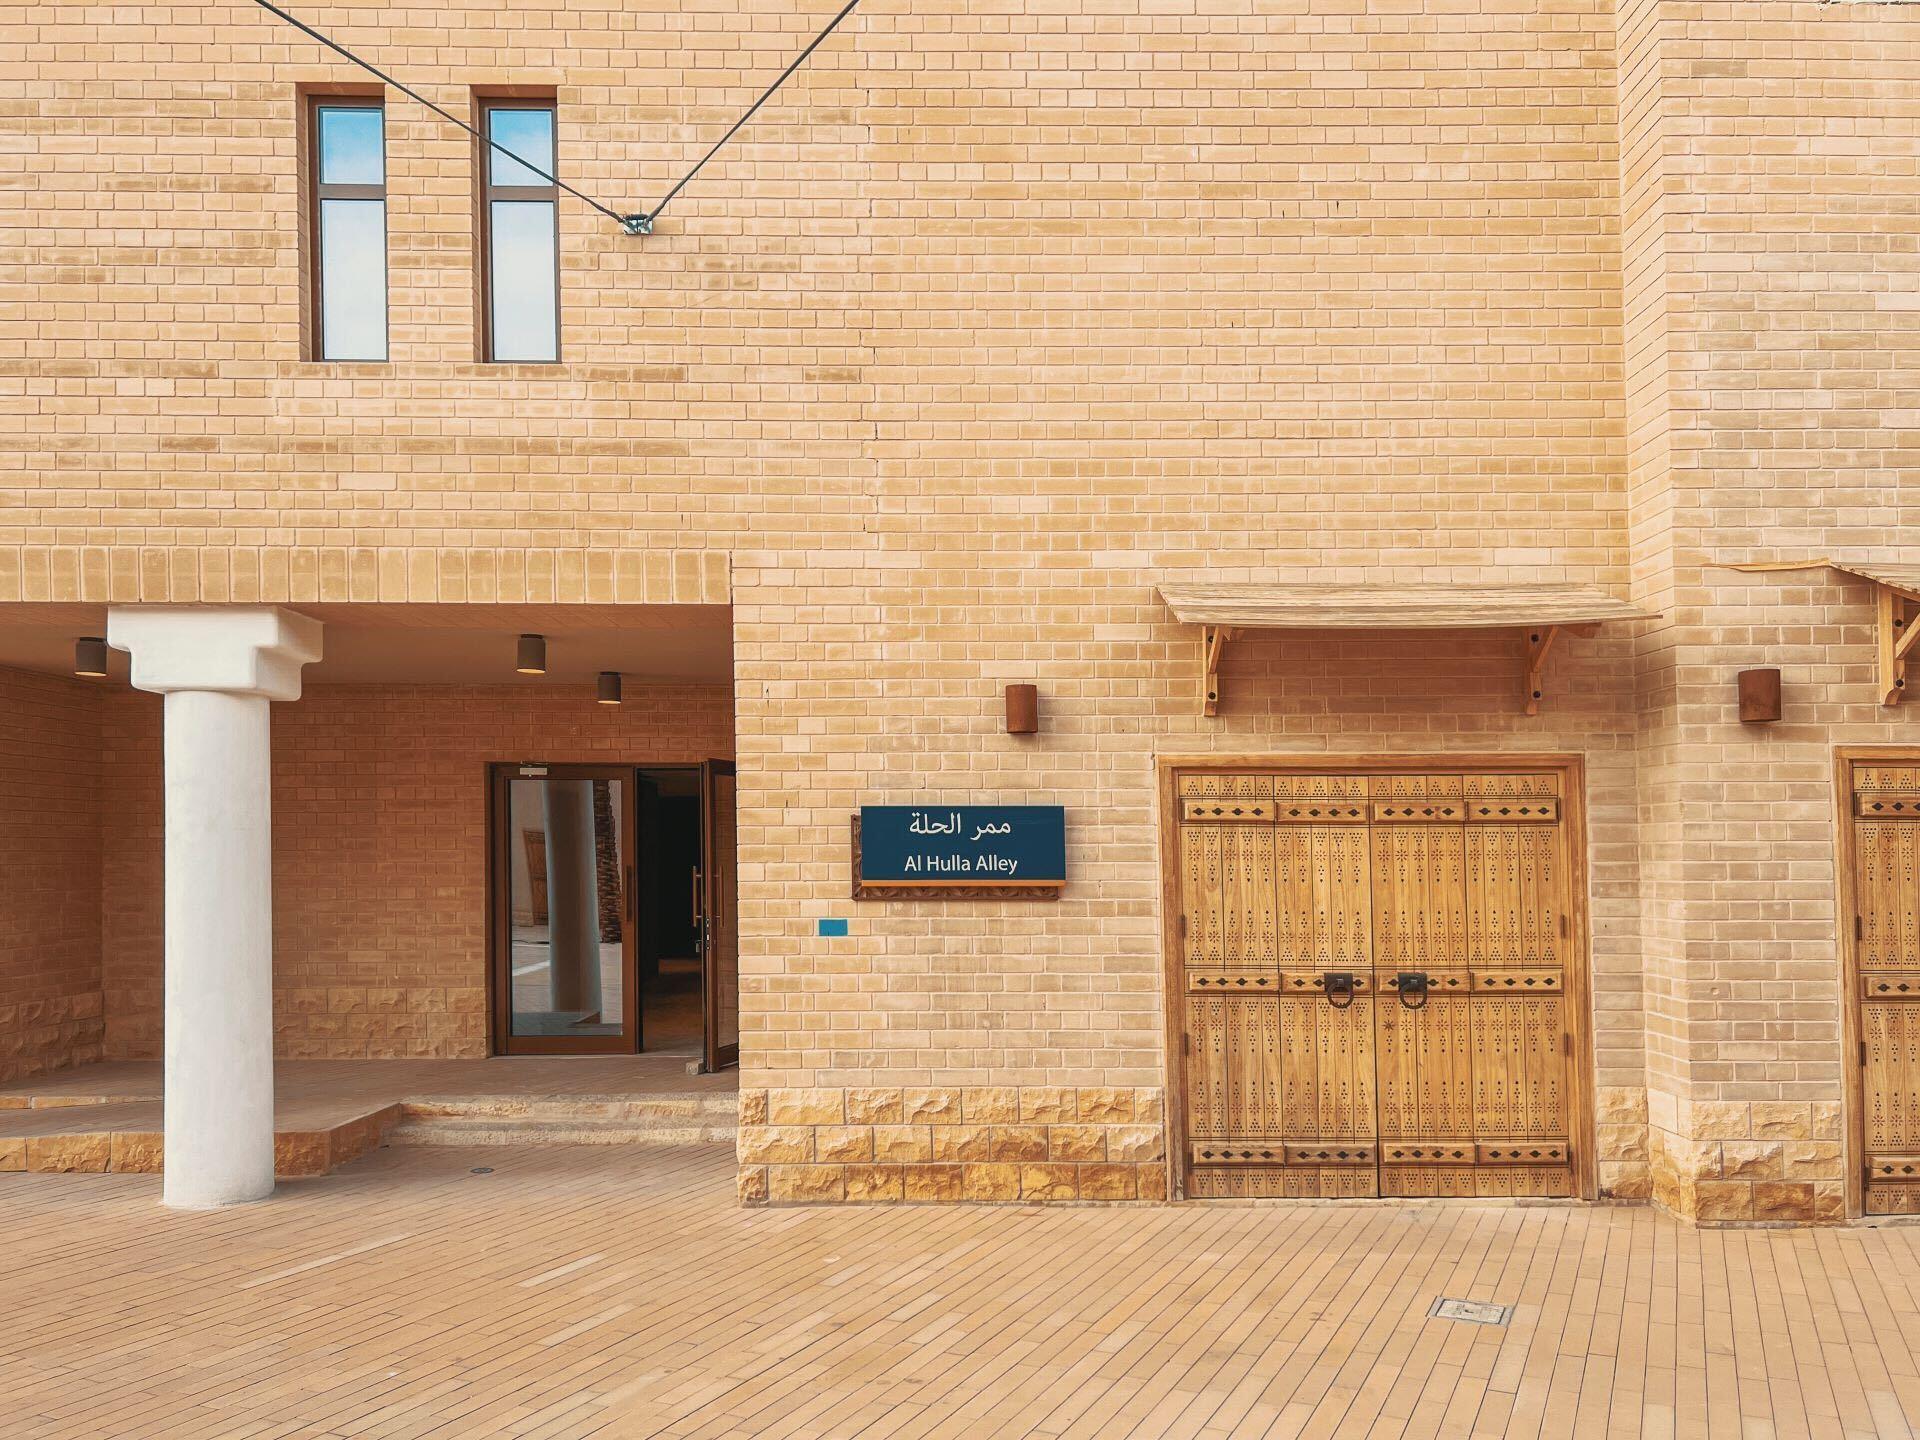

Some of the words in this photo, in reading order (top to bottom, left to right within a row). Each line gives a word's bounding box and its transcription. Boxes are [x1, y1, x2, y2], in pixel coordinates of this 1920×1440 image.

[909, 812, 961, 835] الحلة
[970, 821, 1011, 841] ممر
[904, 854, 922, 872] Al
[927, 854, 971, 872] Hulla
[975, 854, 1018, 875] Alley
